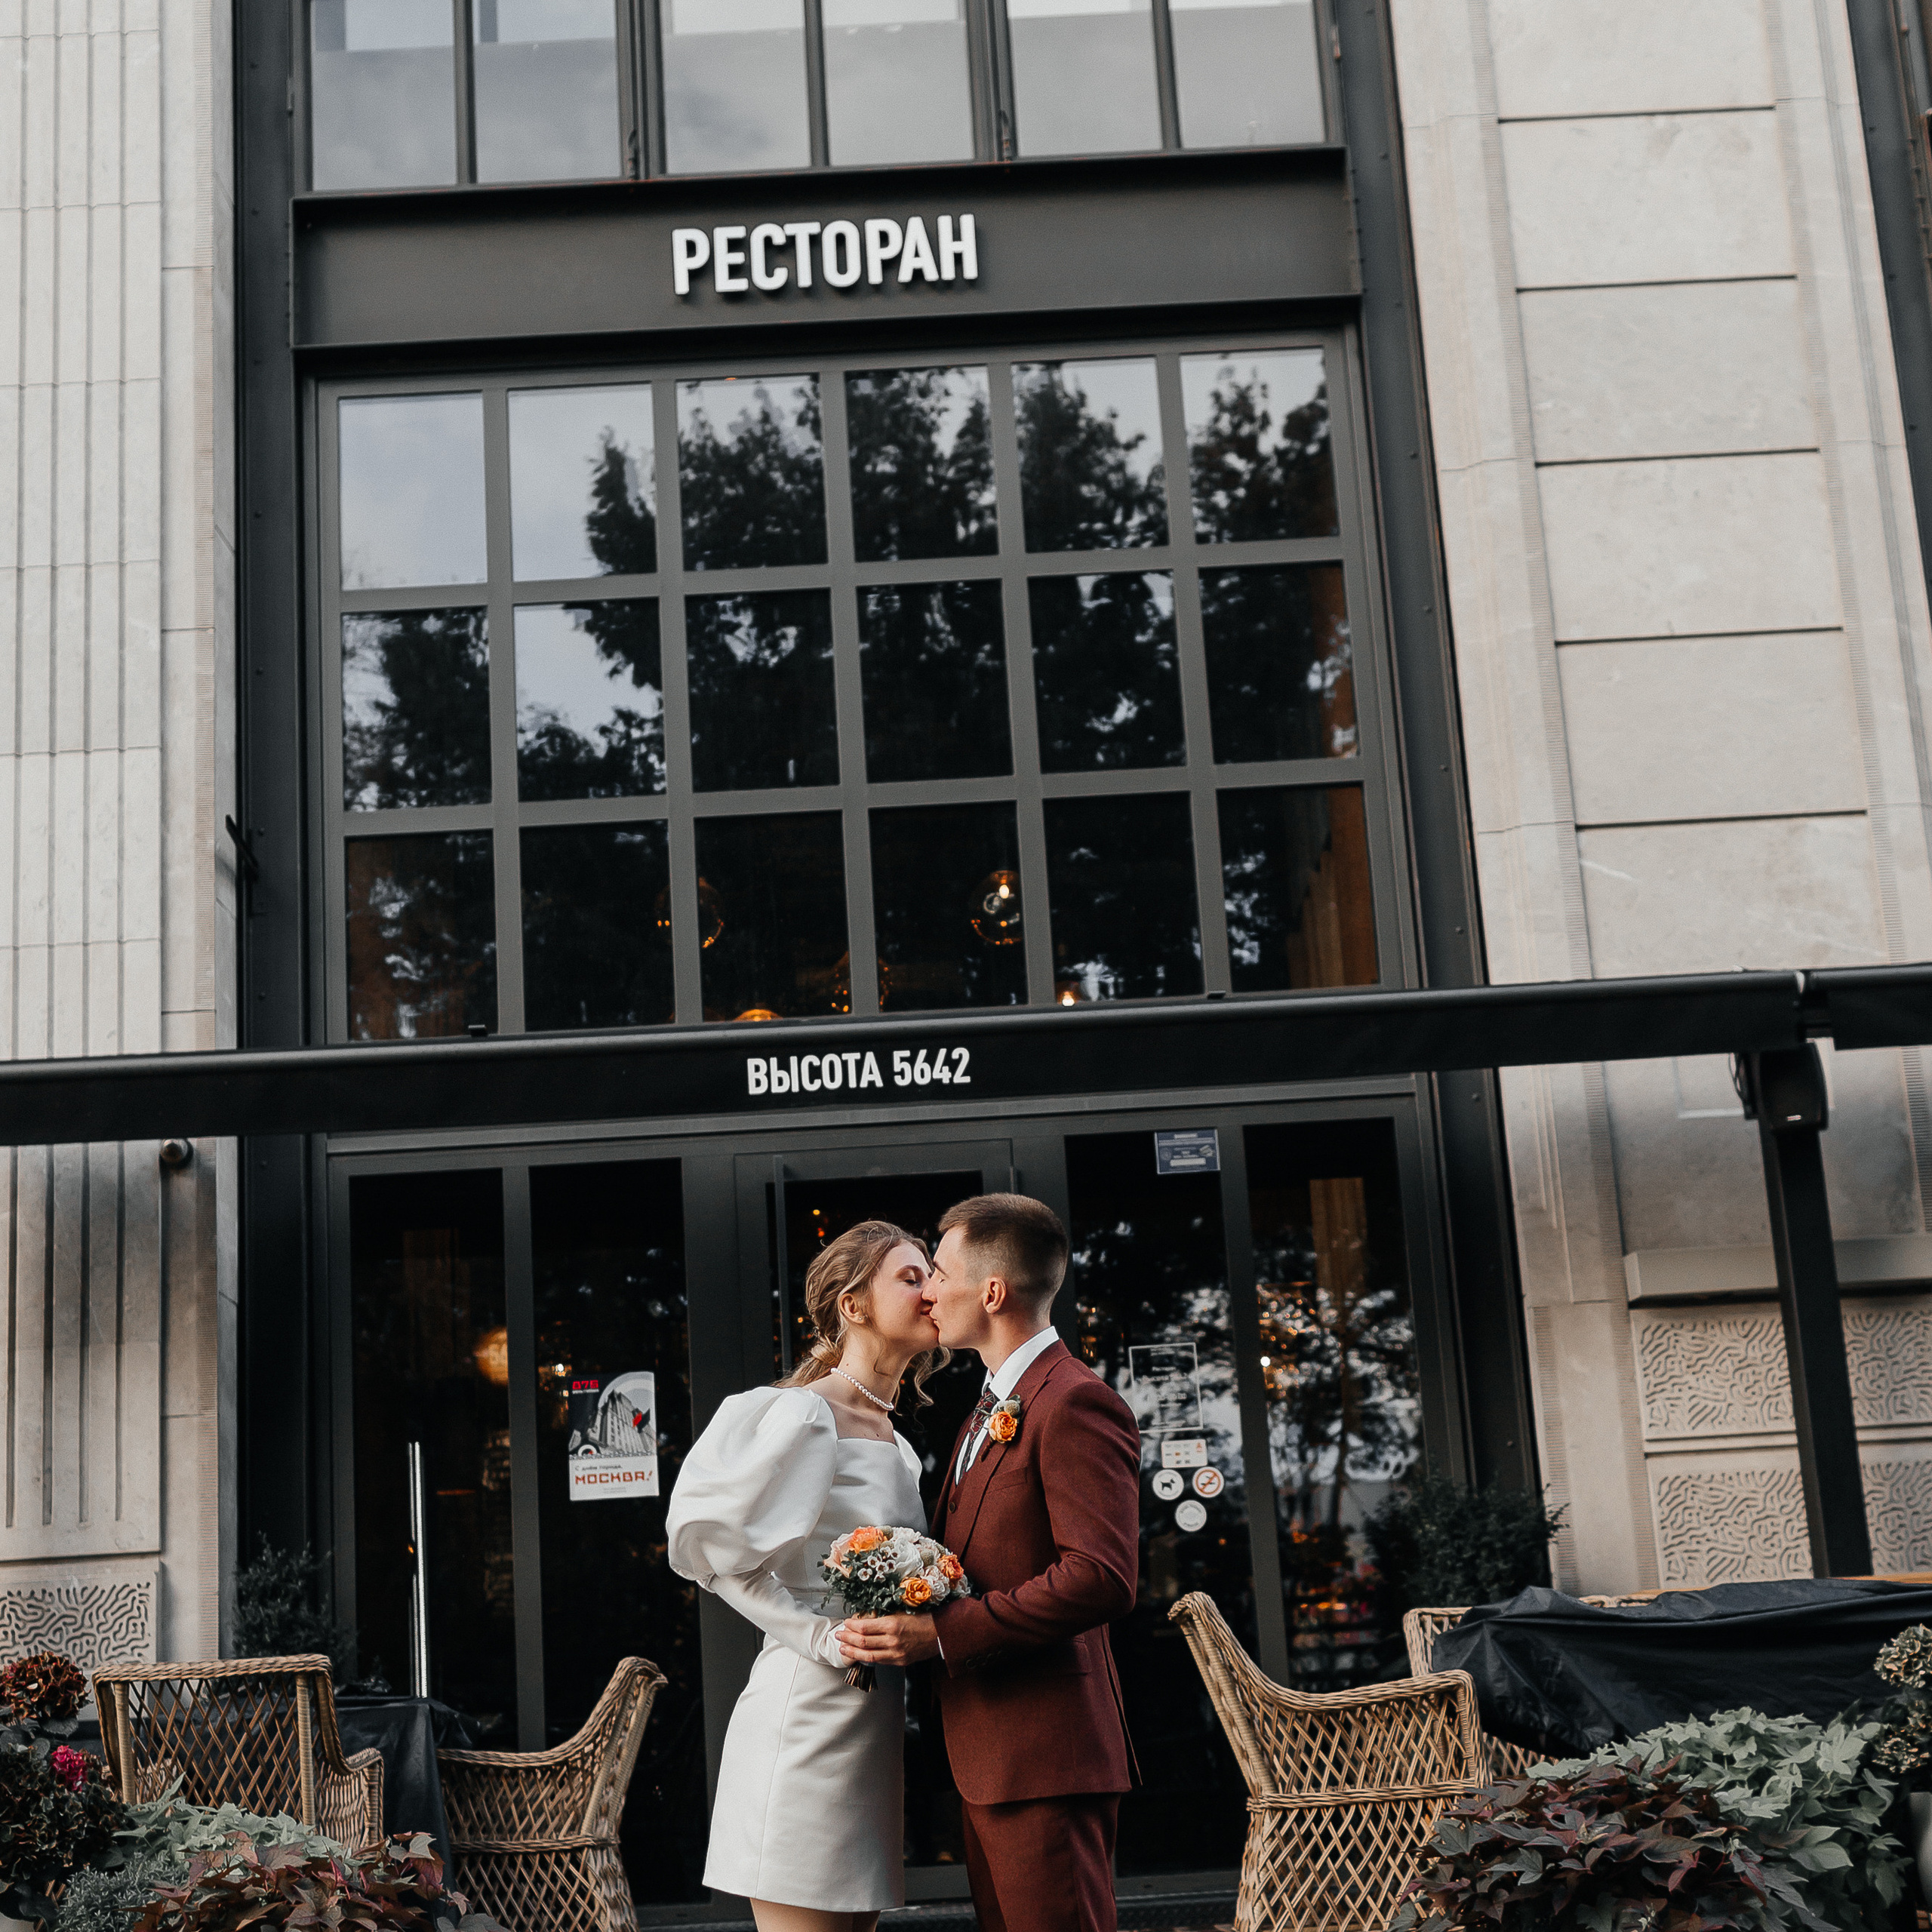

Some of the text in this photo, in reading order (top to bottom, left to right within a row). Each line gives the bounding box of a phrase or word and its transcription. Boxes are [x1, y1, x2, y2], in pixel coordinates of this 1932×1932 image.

[672, 214, 979, 295] РЕСТОРАН
[746, 1047, 971, 1095] ВЫСОТА 5642
